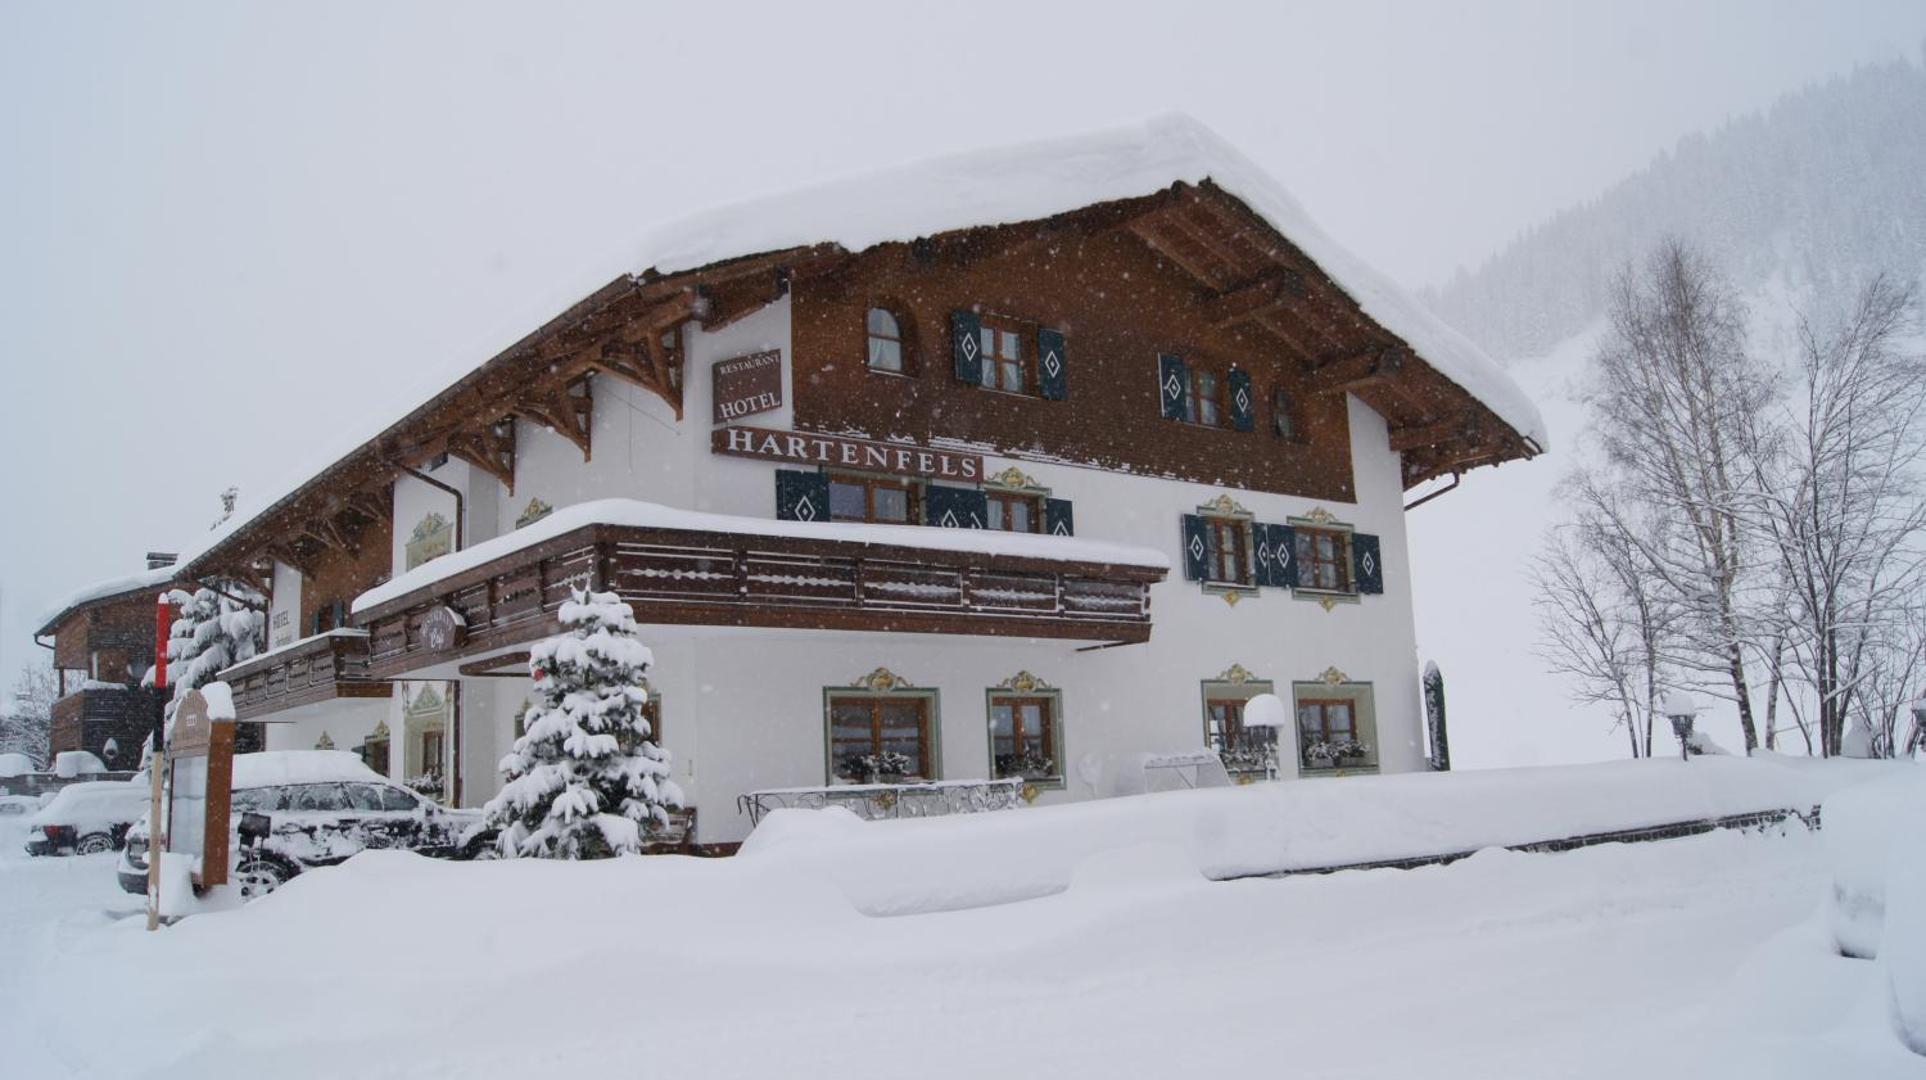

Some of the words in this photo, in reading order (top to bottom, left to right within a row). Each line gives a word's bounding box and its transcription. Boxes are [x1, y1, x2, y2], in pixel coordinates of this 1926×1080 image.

[719, 353, 780, 375] RESTAURANT
[719, 392, 781, 418] HOTEL
[727, 428, 977, 478] HARTENFELS
